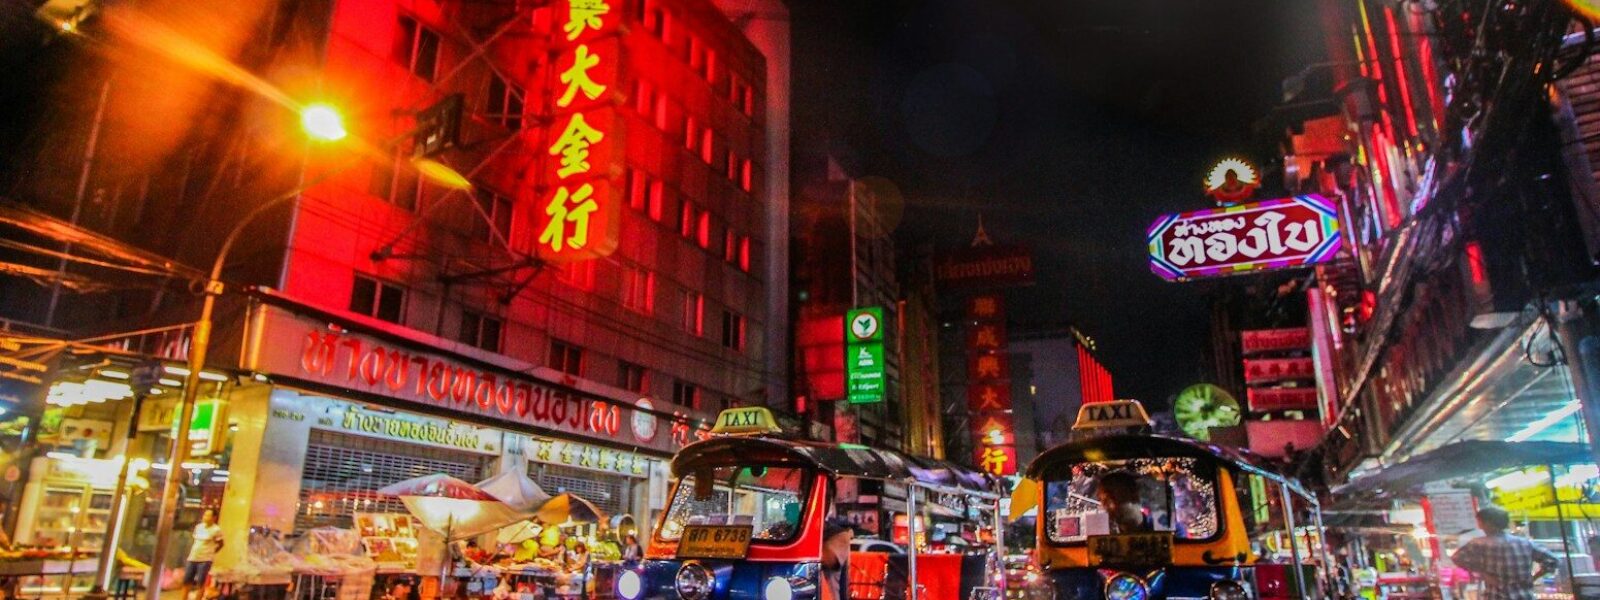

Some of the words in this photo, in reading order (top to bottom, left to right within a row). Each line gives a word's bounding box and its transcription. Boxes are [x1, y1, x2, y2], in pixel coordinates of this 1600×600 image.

[1168, 210, 1320, 266] ทองใบ
[724, 411, 759, 426] TAXI
[1086, 402, 1133, 421] TAXI
[714, 528, 748, 542] 6738
